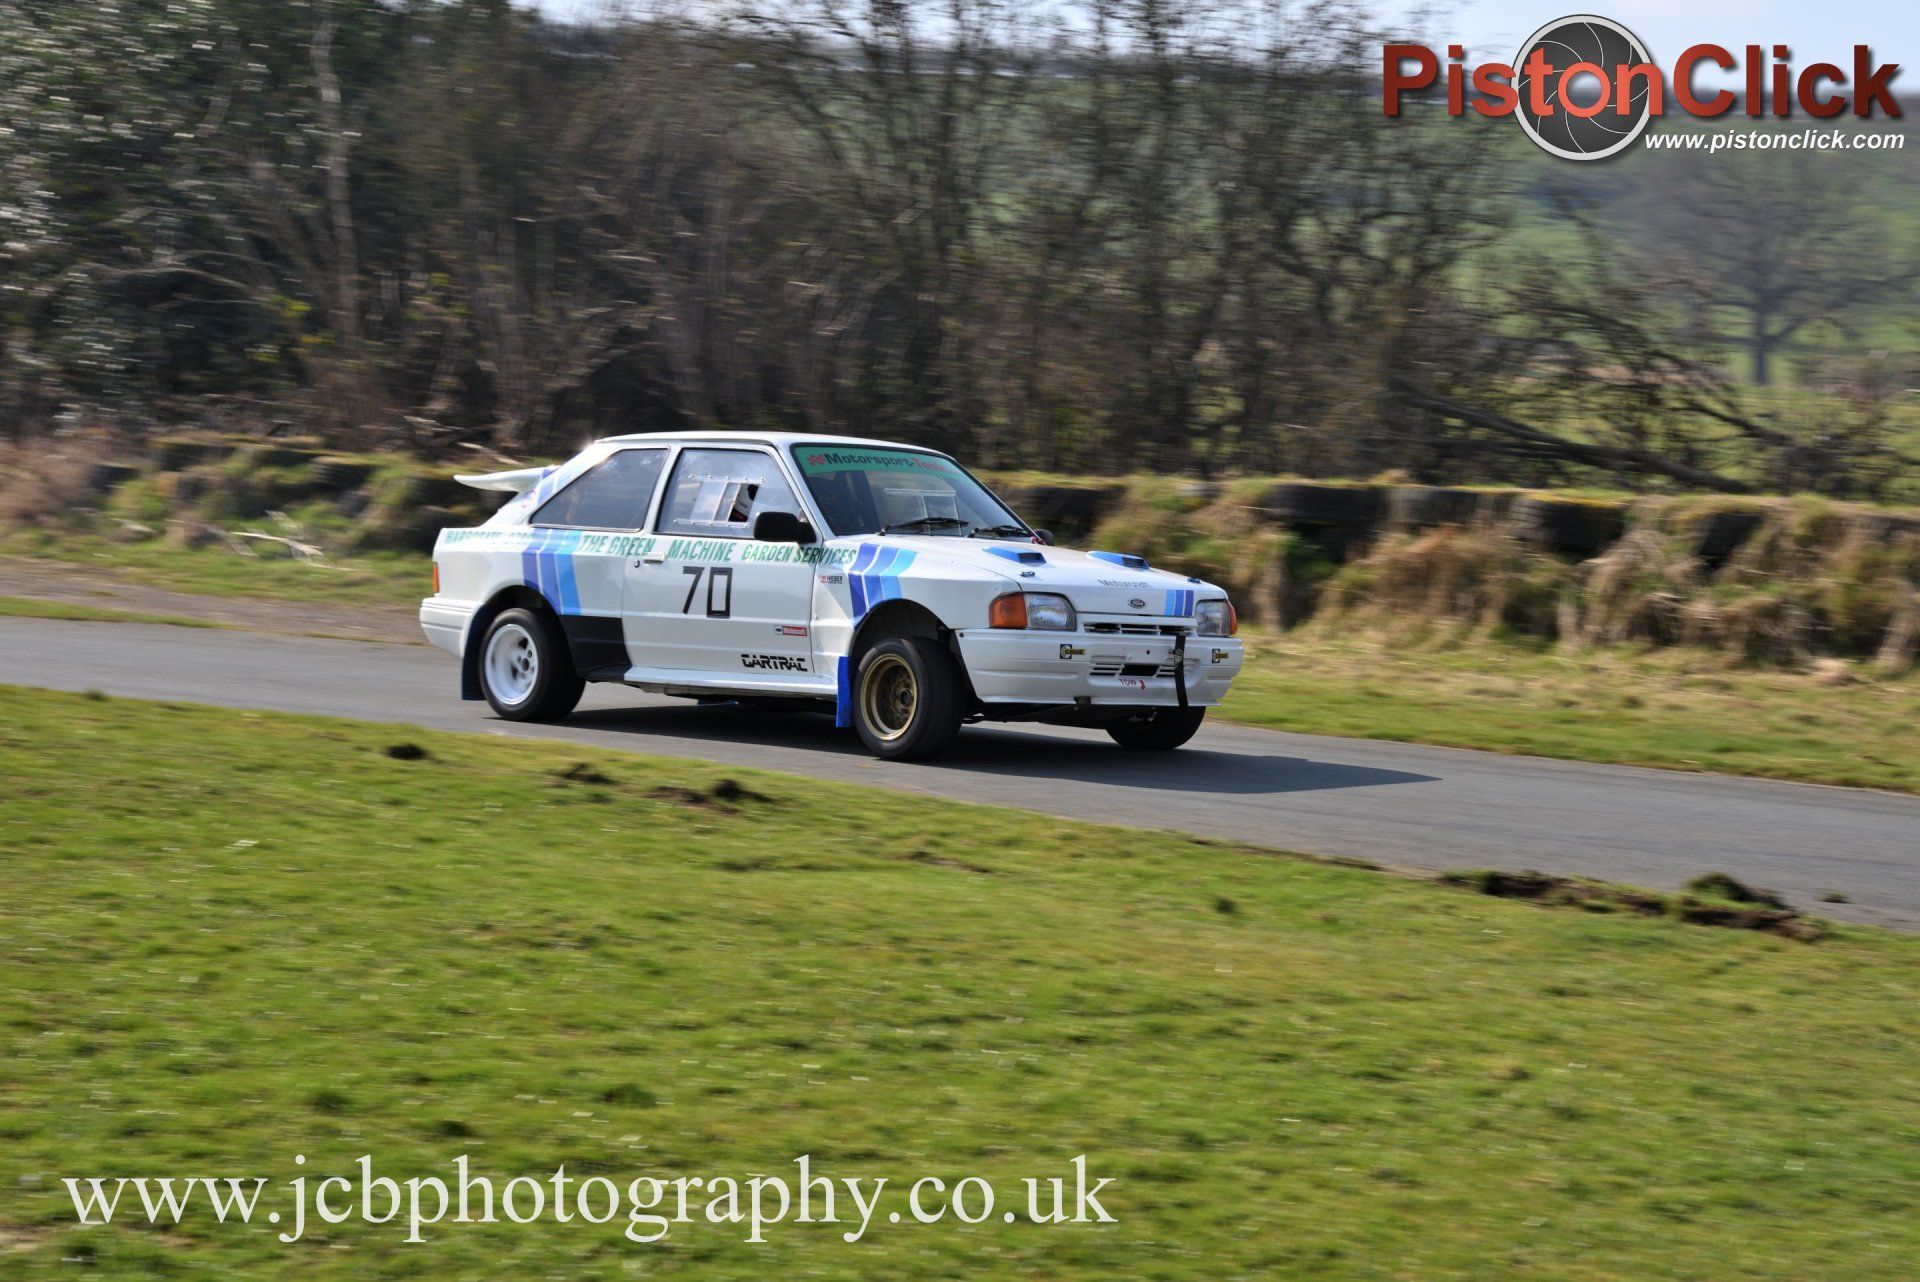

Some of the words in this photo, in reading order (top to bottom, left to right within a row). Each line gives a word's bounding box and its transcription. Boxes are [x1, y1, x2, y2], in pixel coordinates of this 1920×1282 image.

[581, 535, 608, 553] THE
[608, 537, 656, 557] GREEN
[667, 539, 738, 563] MACHINE
[741, 544, 794, 563] GARDEN
[793, 548, 857, 564] SERVICES
[682, 565, 733, 619] 70
[741, 653, 808, 672] CARTRAC
[1119, 678, 1137, 687] TOW
